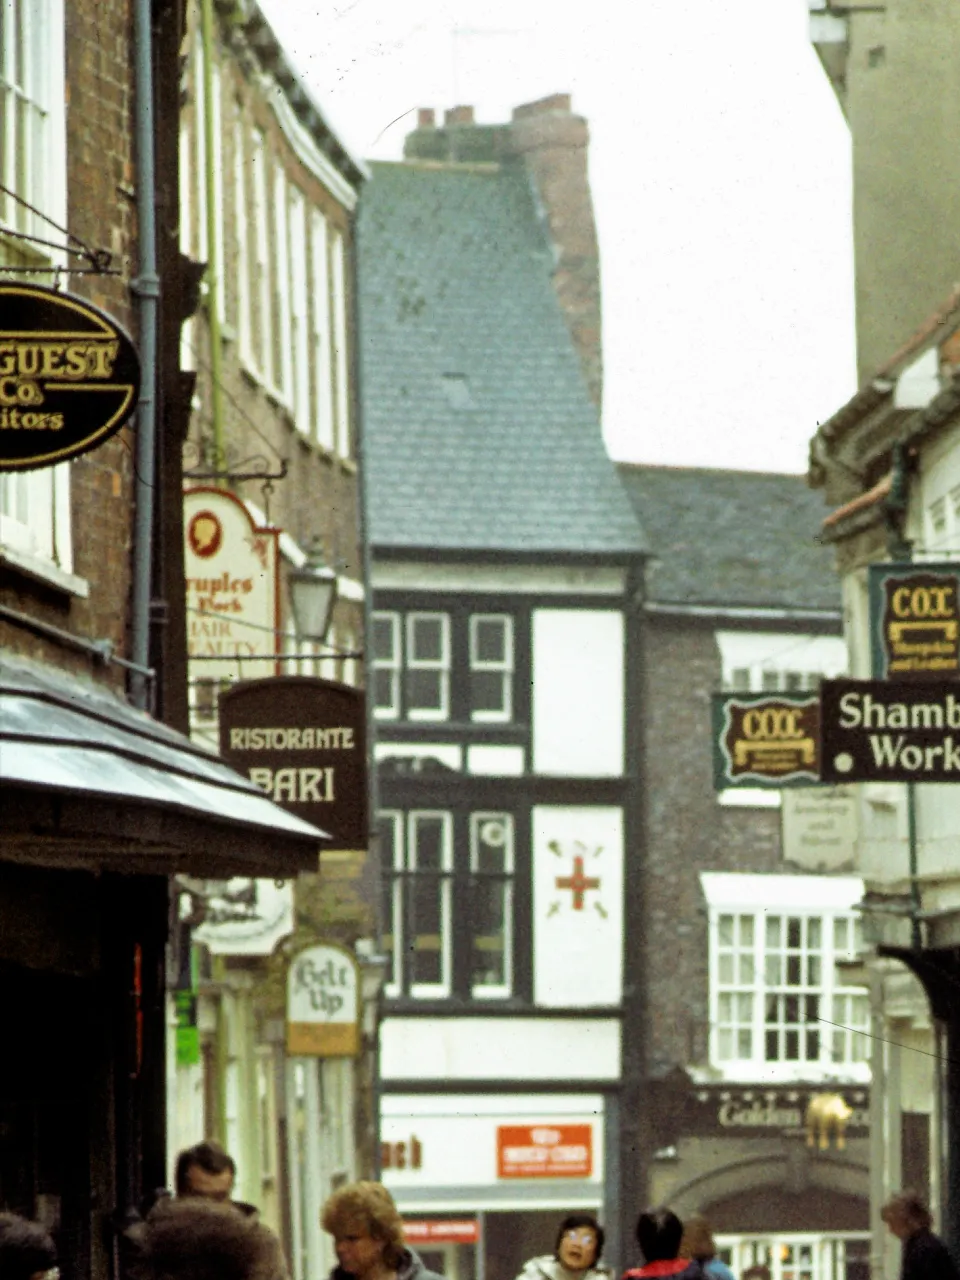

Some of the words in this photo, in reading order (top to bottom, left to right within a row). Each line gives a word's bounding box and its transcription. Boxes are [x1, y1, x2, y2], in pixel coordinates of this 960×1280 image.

[892, 587, 954, 618] COX
[229, 727, 355, 750] RISTORANTE
[249, 767, 335, 802] BARI
